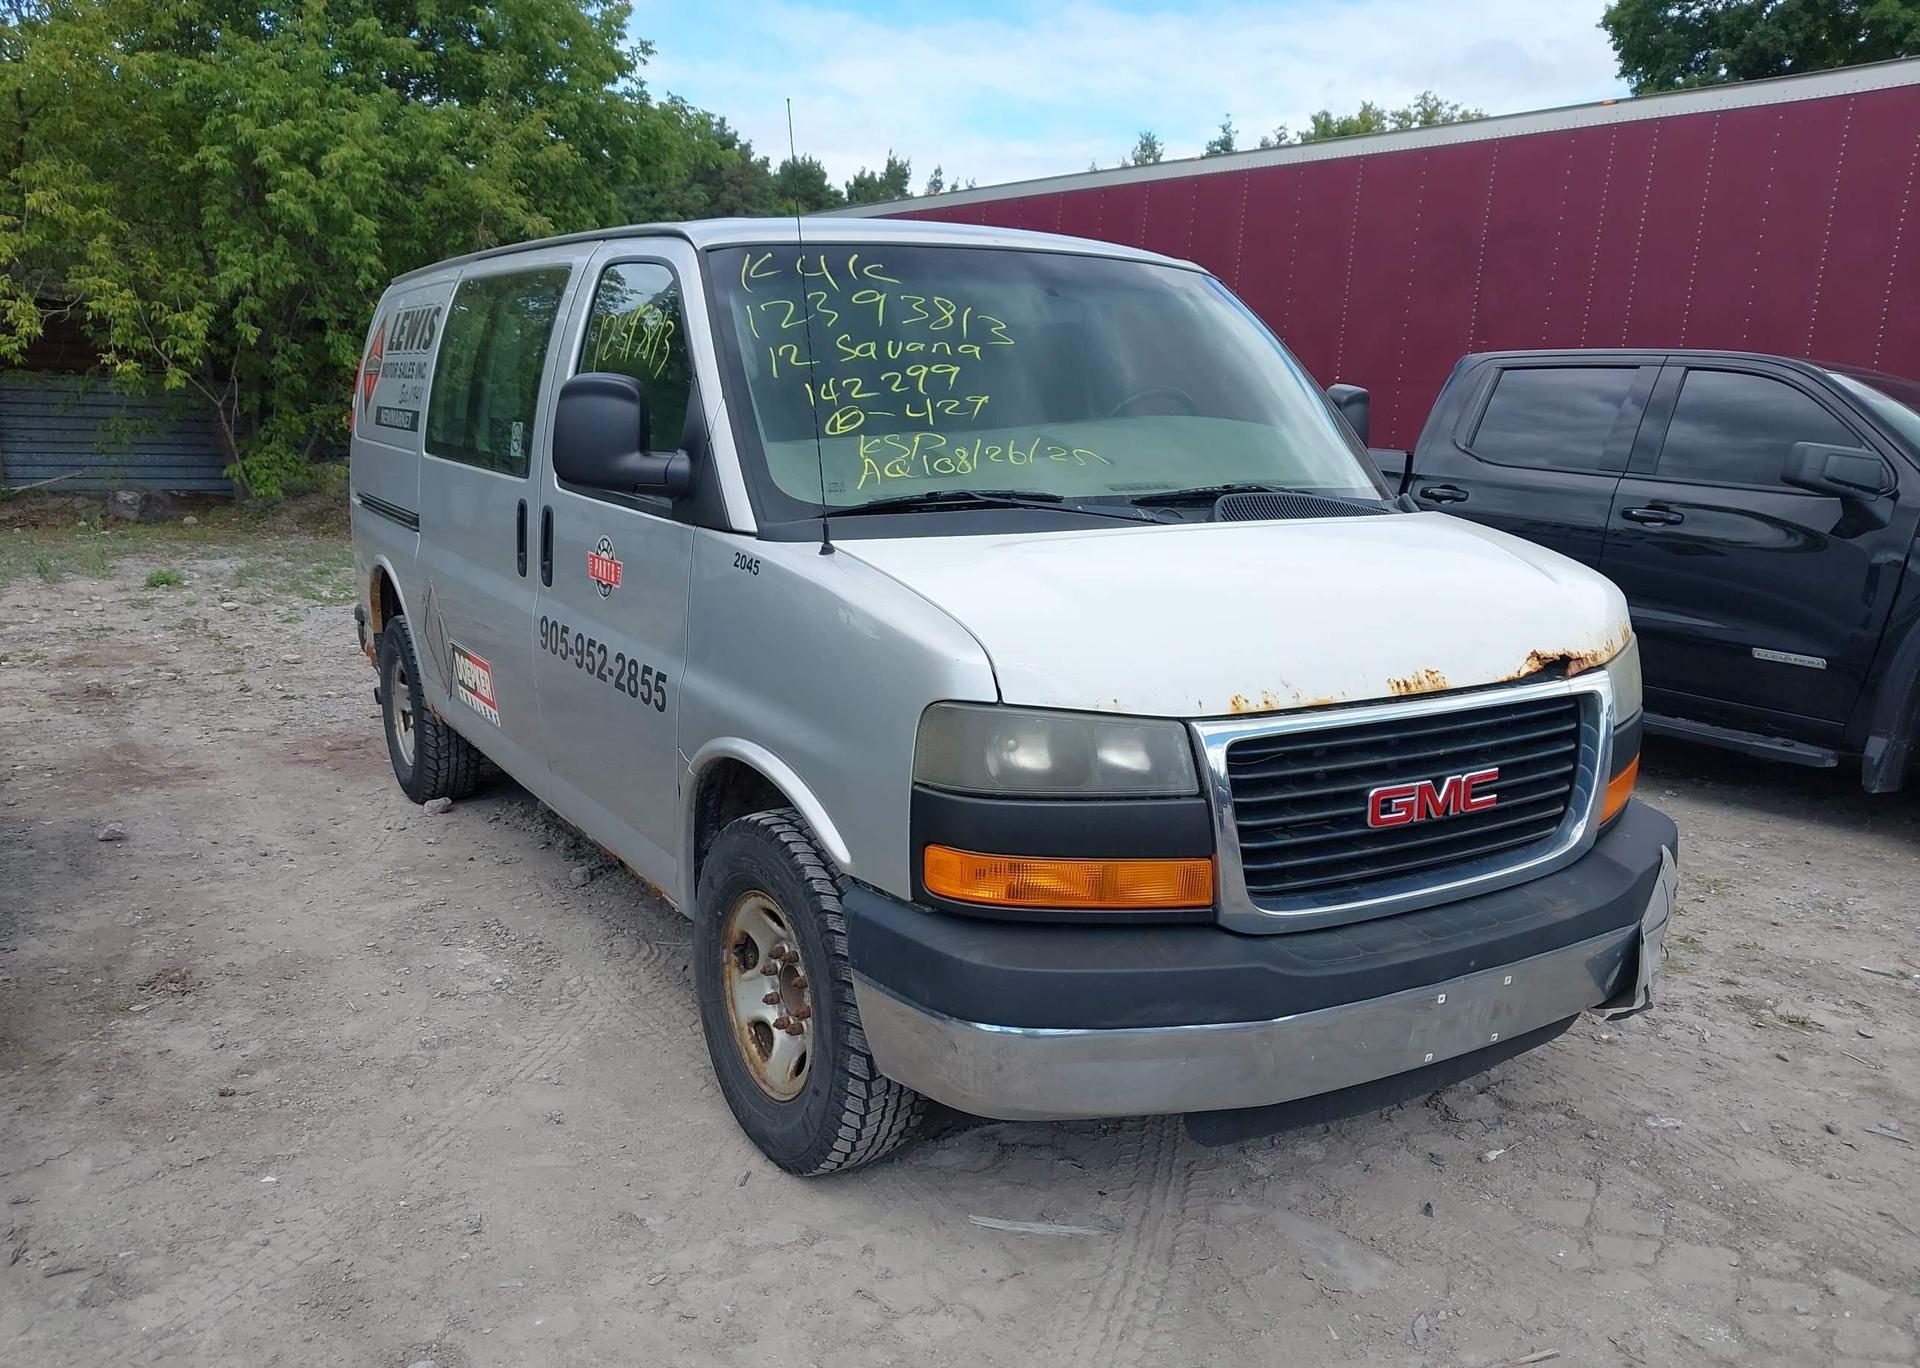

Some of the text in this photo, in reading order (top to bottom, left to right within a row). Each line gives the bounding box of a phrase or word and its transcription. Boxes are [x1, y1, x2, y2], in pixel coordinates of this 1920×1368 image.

[387, 306, 442, 352] LEWIS
[770, 344, 820, 378] 12
[734, 552, 760, 576] 2045
[540, 615, 668, 713] 905-952-2855
[1367, 767, 1499, 829] GMC
